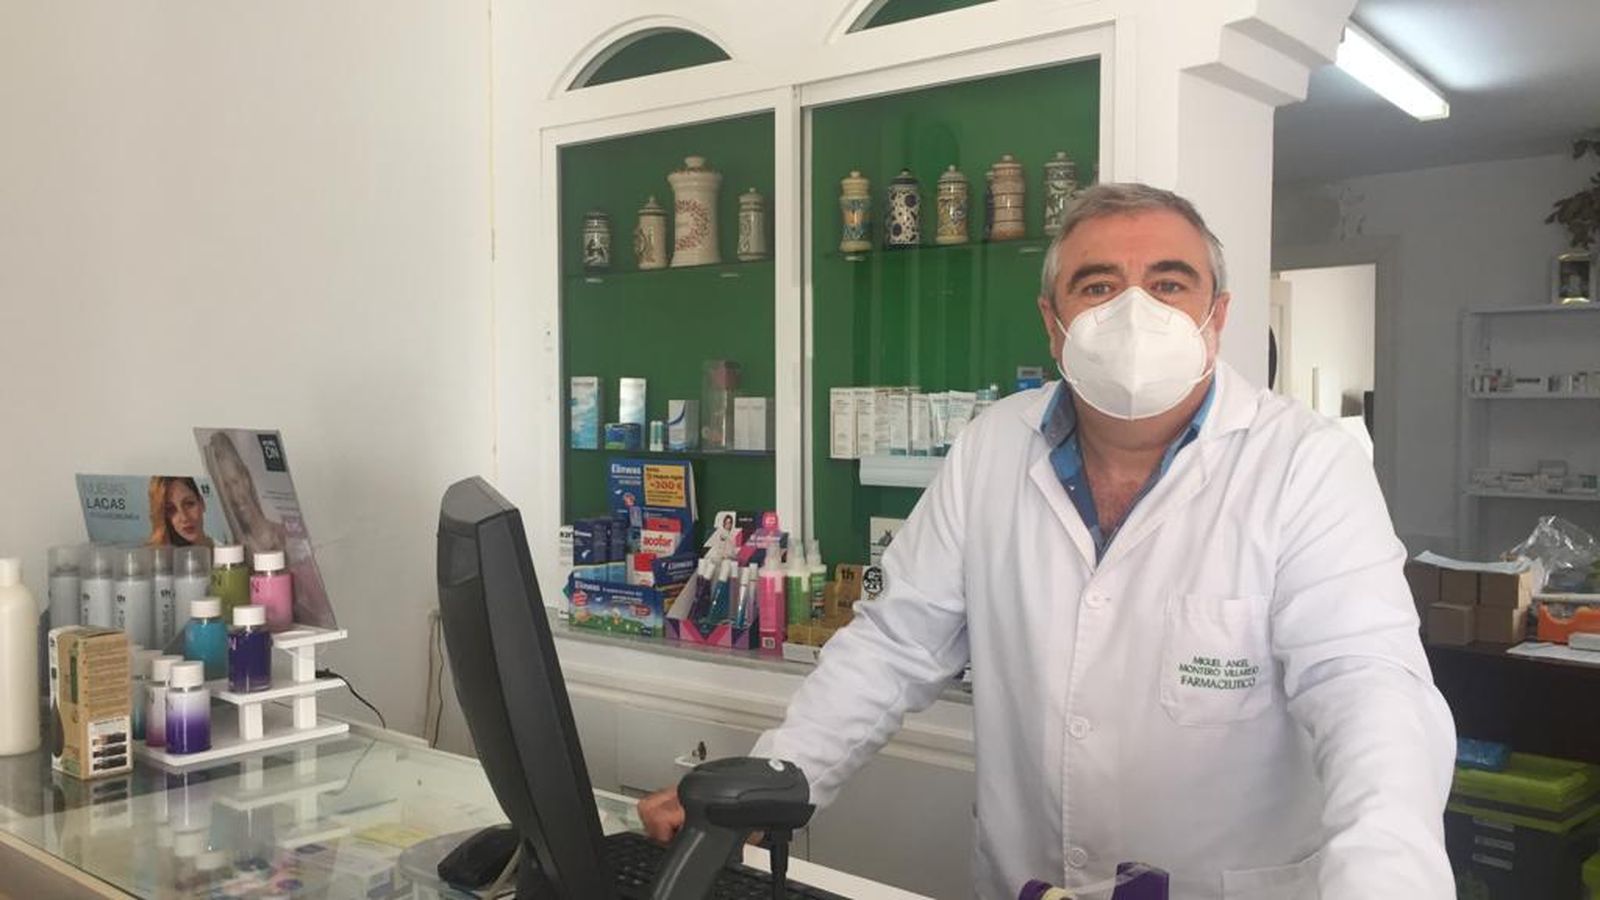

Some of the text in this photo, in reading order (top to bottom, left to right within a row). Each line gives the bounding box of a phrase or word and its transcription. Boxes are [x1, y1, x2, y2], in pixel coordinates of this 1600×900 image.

[86, 498, 126, 511] LACAS
[1193, 656, 1249, 668] MIGUEL ANGEL
[1179, 663, 1221, 677] MONTERO
